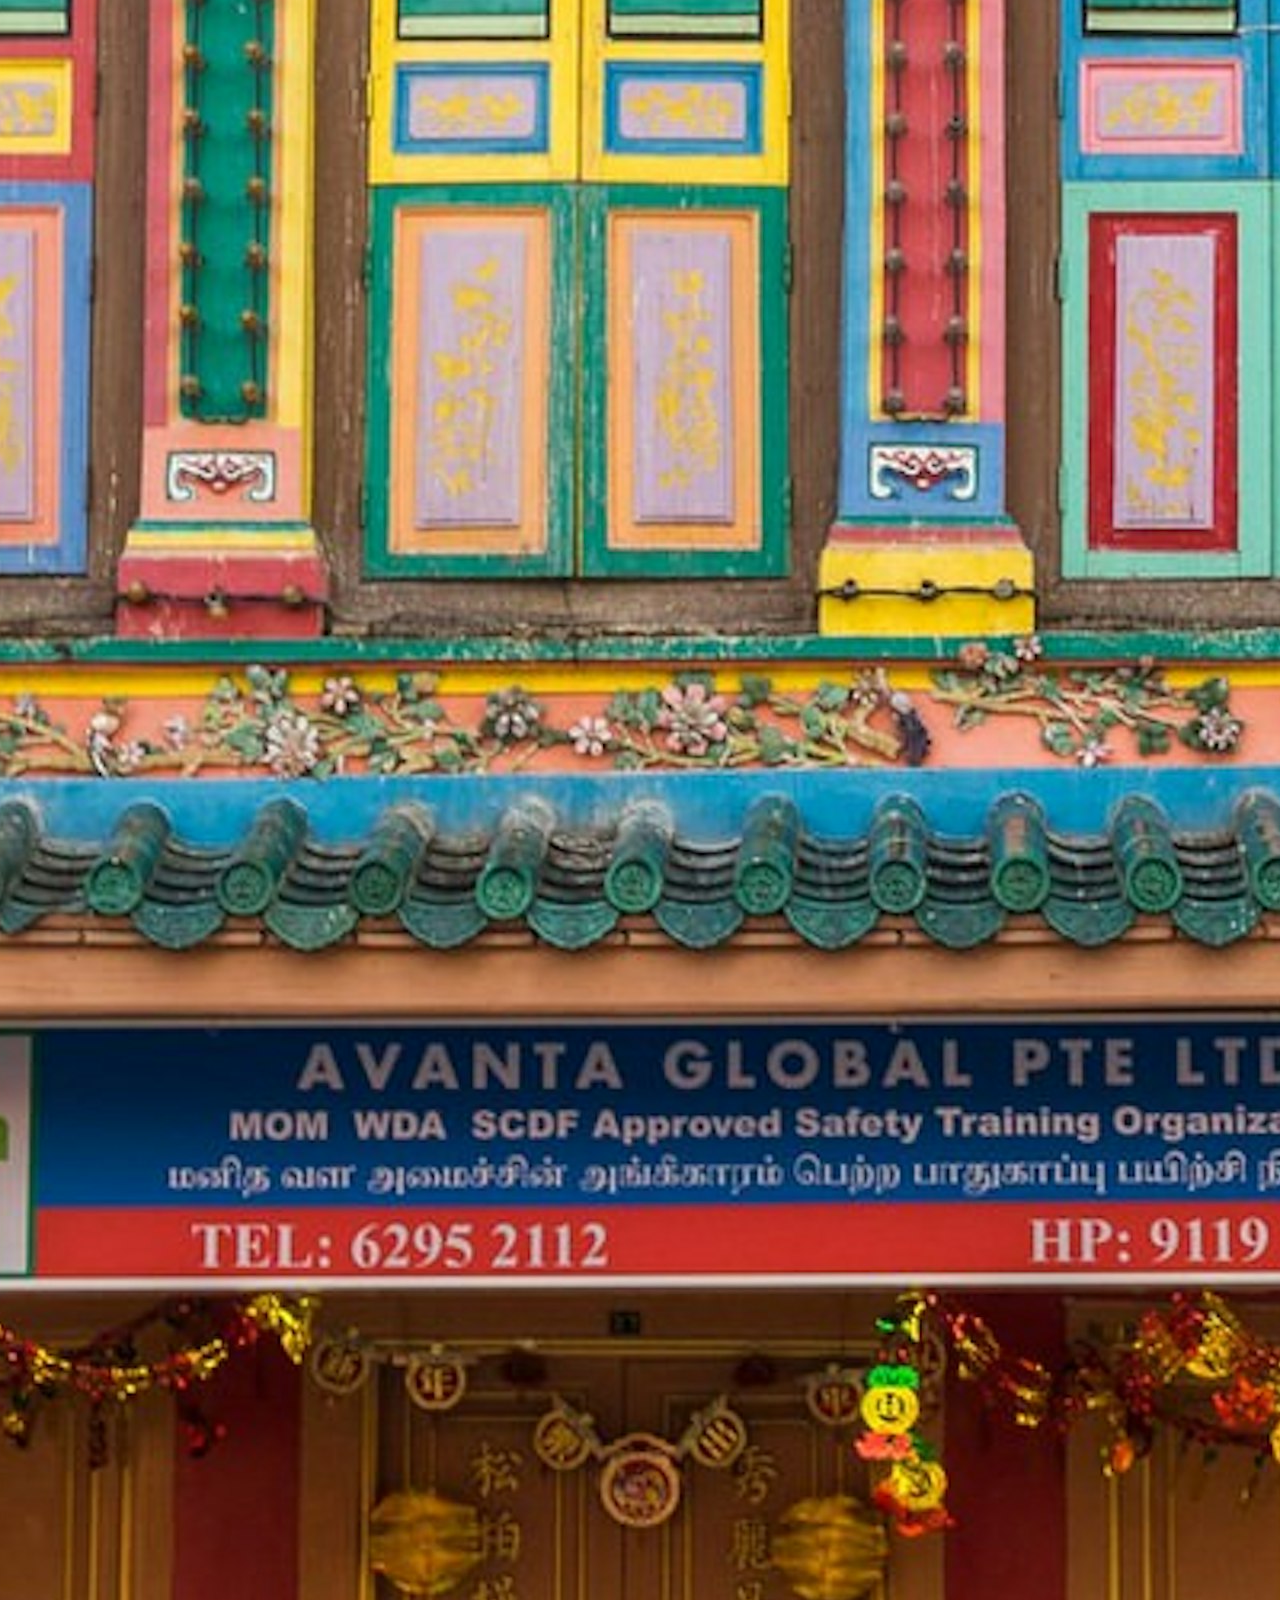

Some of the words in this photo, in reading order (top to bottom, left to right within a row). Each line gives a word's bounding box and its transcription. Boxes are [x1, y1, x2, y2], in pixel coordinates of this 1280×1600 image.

[297, 1041, 623, 1091] AVANTA
[663, 1038, 973, 1090] GLOBAL
[1012, 1037, 1135, 1088] PTE
[228, 1110, 328, 1141] MOM
[353, 1109, 447, 1140] WDA
[471, 1108, 581, 1140] SCDF
[592, 1107, 783, 1145] Approved
[794, 1106, 923, 1144] Safety
[934, 1105, 1100, 1144] Training
[167, 1154, 272, 1198] மனித
[280, 1161, 356, 1190] வள
[793, 1152, 901, 1196] பெற்ற
[913, 1152, 1106, 1196] பாதுகாப்பு
[1117, 1148, 1247, 1193] பயிற்சி
[191, 1222, 331, 1269] TEL:
[349, 1221, 475, 1269] 6295
[490, 1221, 608, 1268] 2112
[1029, 1217, 1132, 1264] HP:
[1149, 1216, 1270, 1264] 9119
